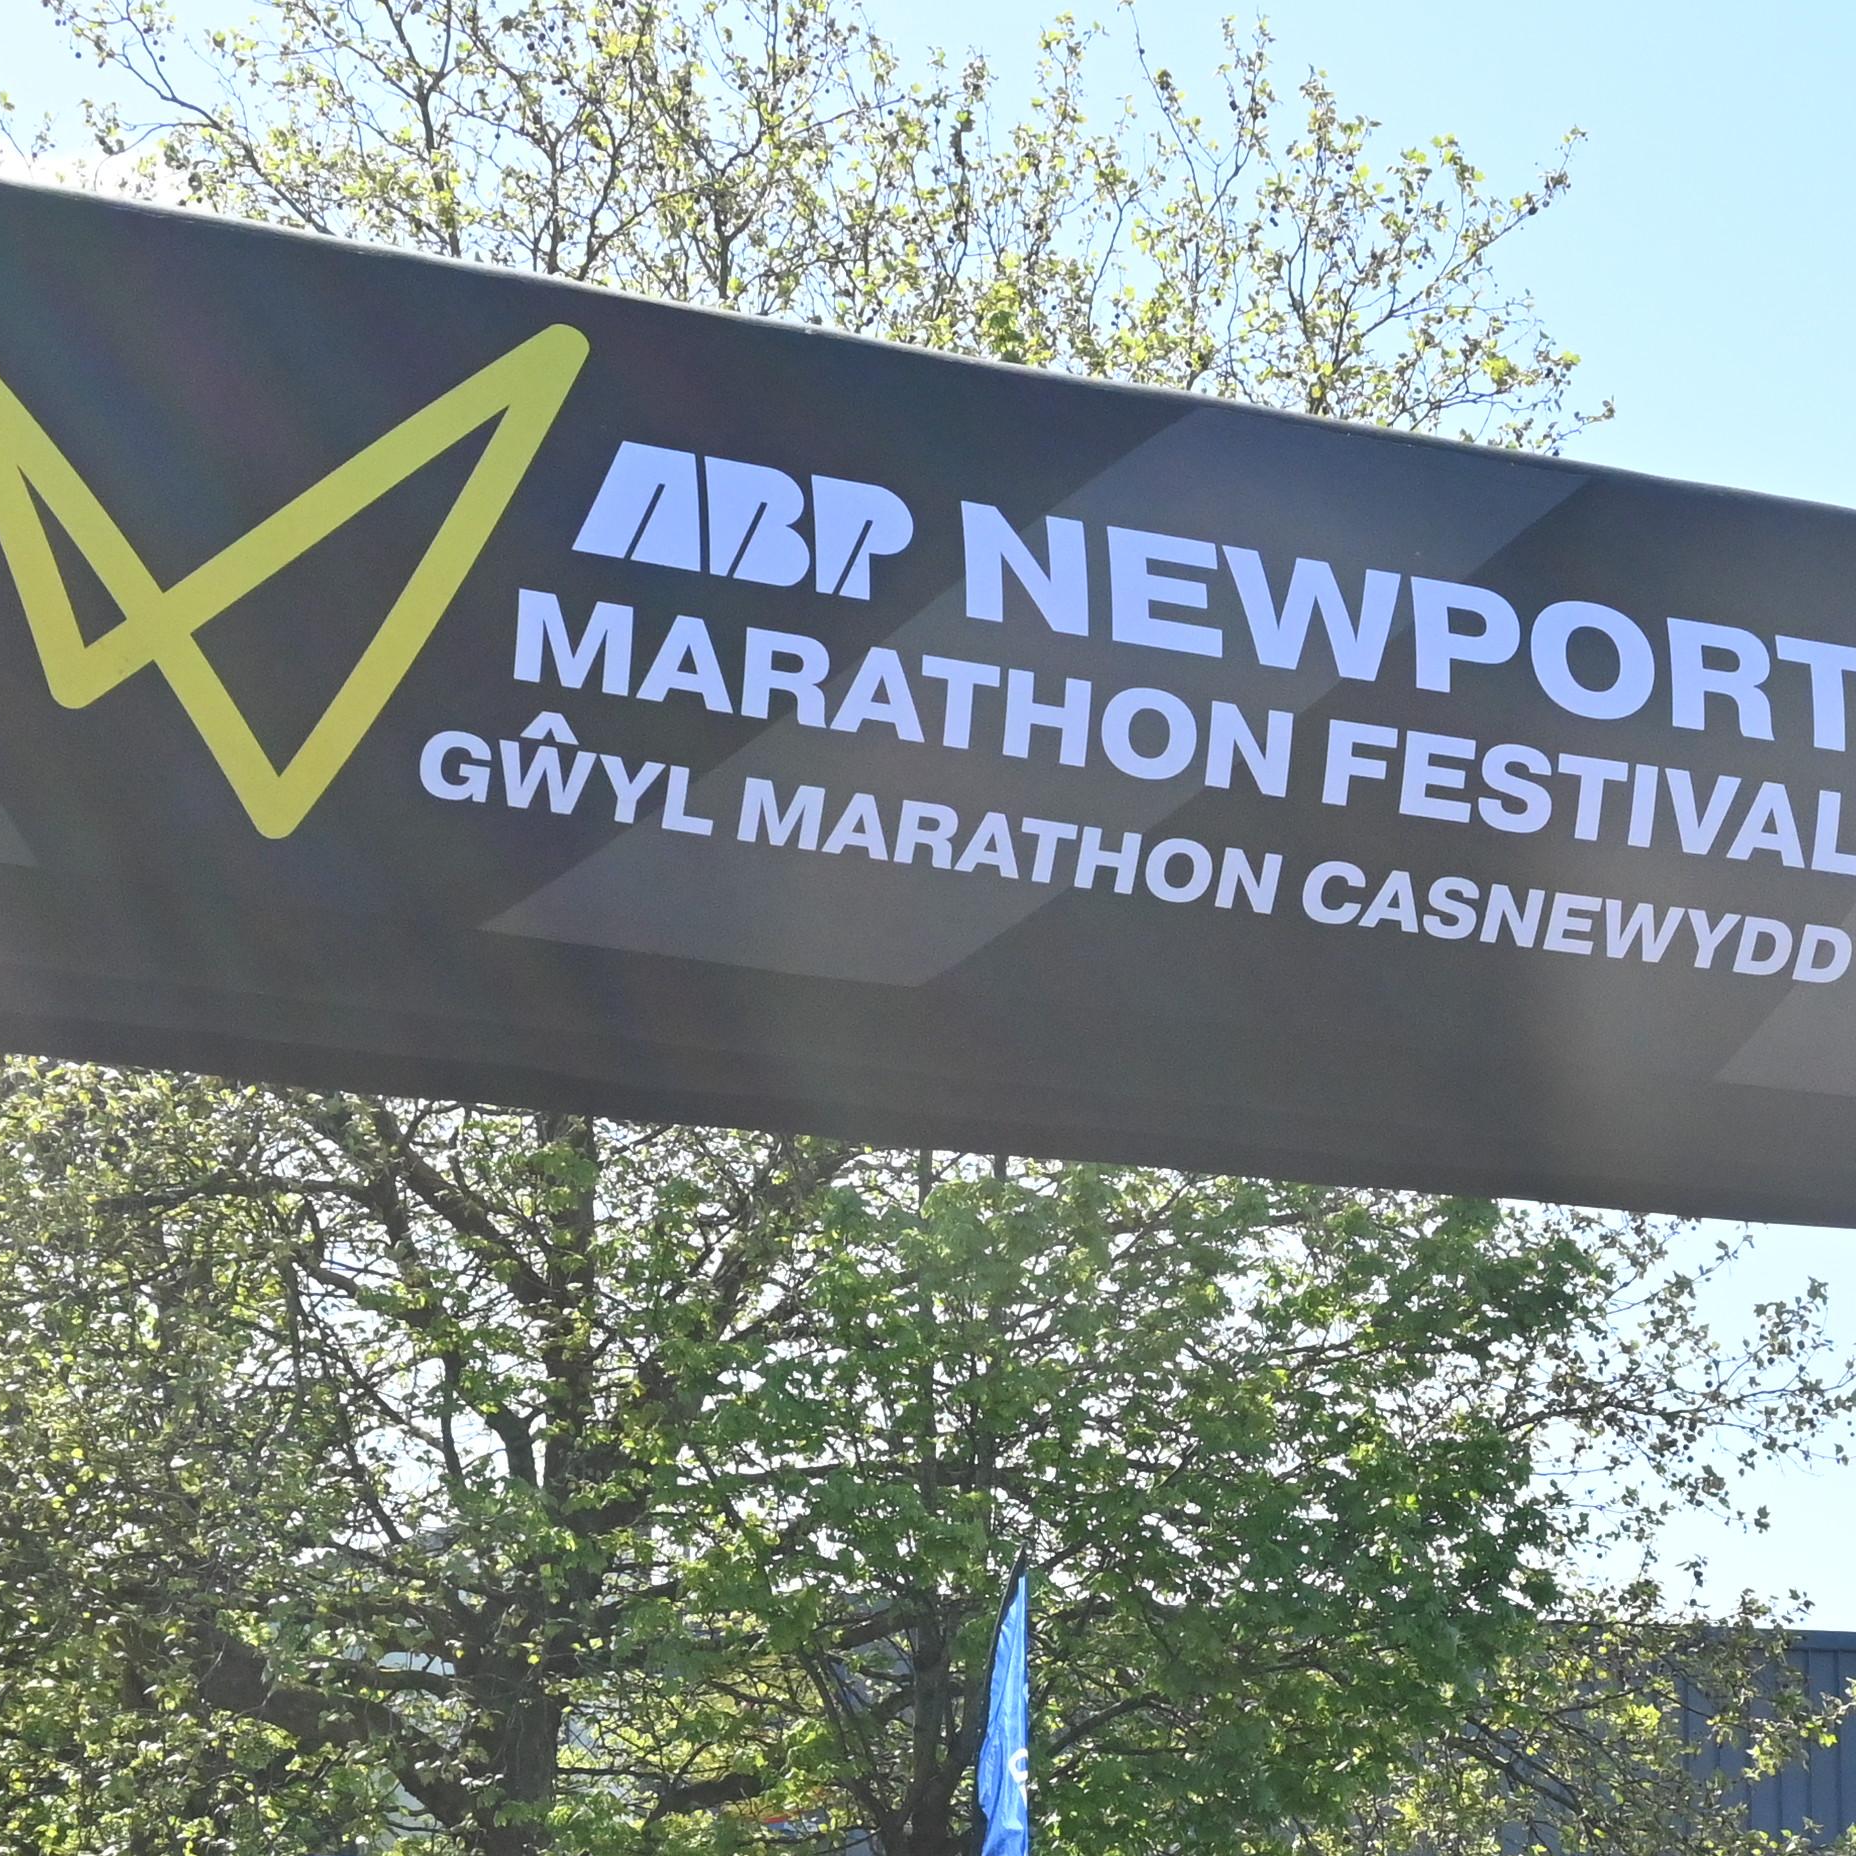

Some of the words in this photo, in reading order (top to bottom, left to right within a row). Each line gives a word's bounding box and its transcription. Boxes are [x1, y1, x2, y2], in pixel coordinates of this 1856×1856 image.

[572, 441, 913, 600] ABP
[514, 589, 1293, 797] MARATHON
[420, 711, 713, 836] GŴYL
[737, 777, 1282, 914] MARATHON
[1303, 861, 1852, 983] CASNEWYDD
